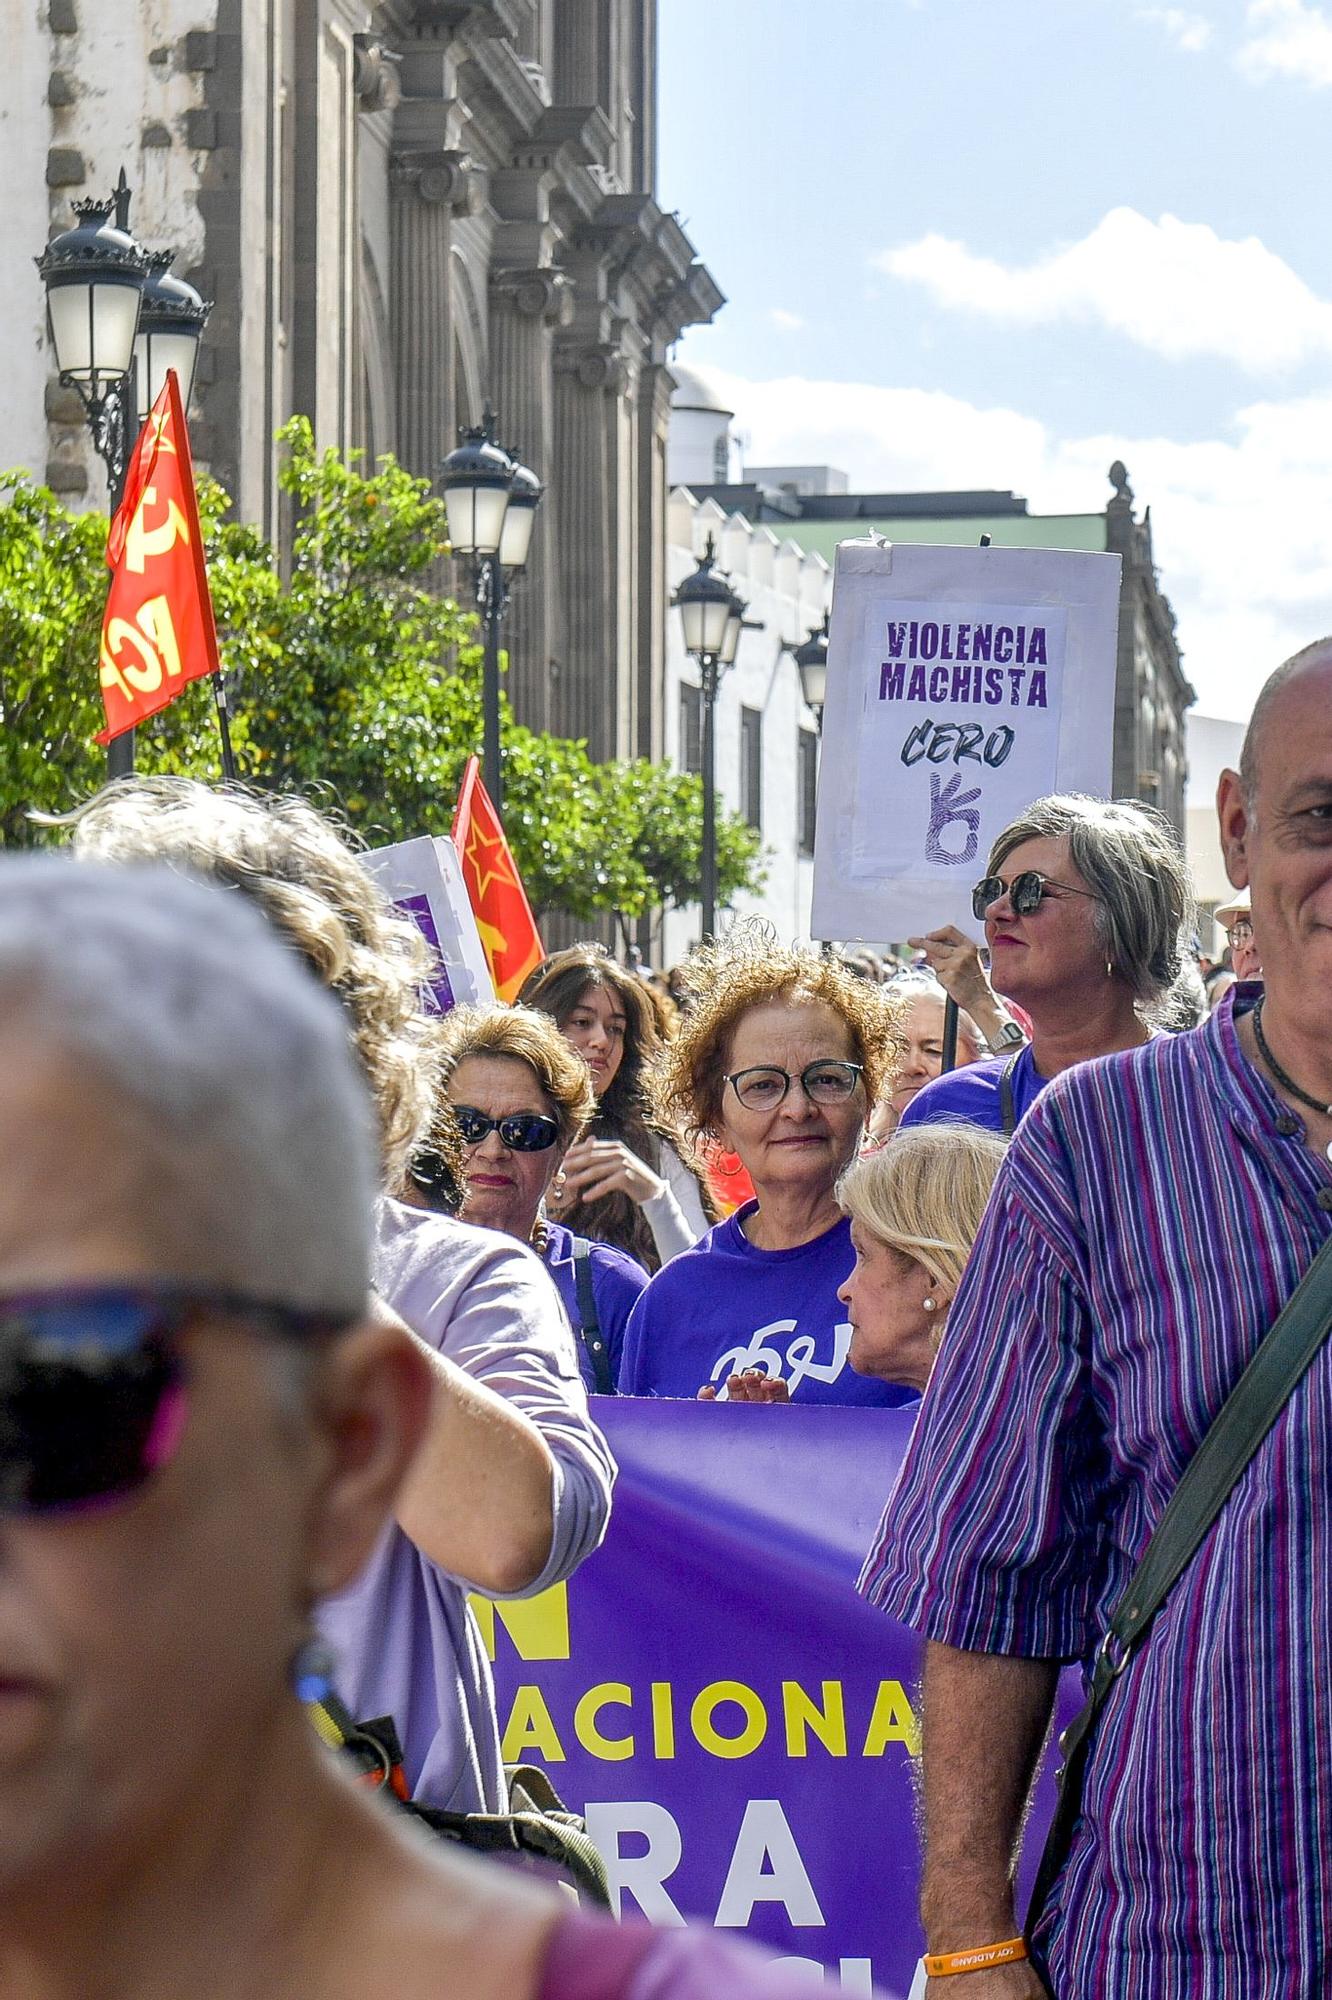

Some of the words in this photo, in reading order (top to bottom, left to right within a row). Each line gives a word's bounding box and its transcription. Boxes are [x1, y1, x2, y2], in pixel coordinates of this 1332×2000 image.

[888, 622, 1047, 663] VIOLENCIA
[879, 663, 1048, 707] MACHISTA
[902, 720, 1015, 768] CERO
[557, 1799, 826, 1927] RA
